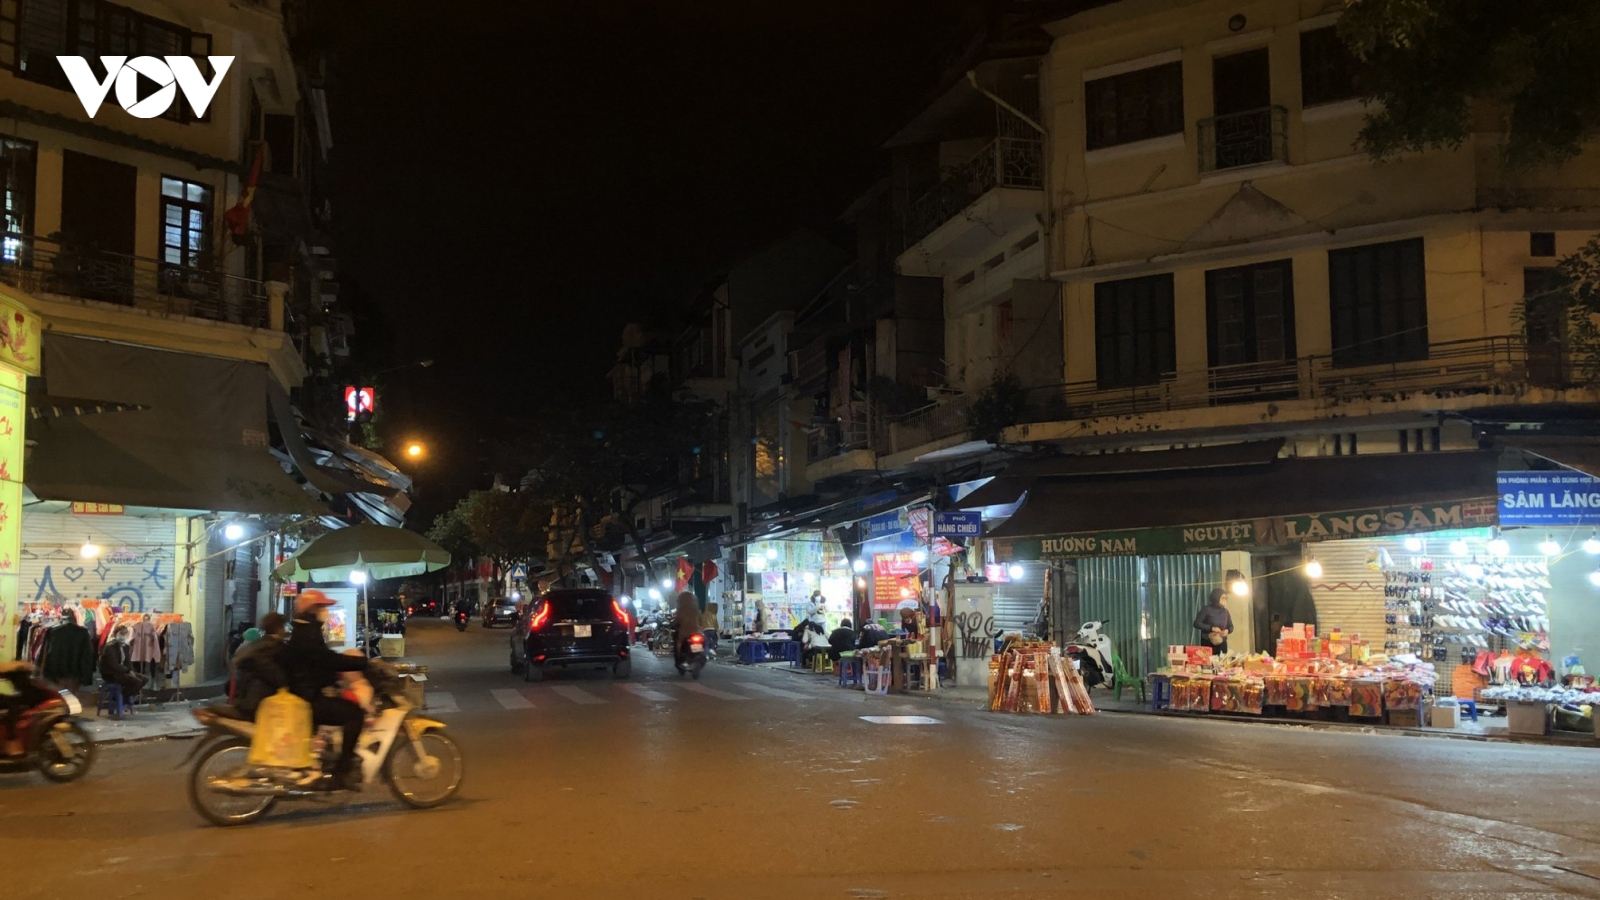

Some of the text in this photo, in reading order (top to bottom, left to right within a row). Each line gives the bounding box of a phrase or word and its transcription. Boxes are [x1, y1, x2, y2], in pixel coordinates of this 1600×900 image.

[1508, 476, 1528, 484] PHÒNG
[1503, 490, 1600, 508] SÂM LĂNG
[937, 521, 977, 533] HÀNG CHIẾU
[1285, 513, 1381, 539] LĂNG
[1384, 505, 1462, 529] SÂM
[1183, 522, 1251, 543] NGUYỆT
[1042, 537, 1137, 553] HƯƠNG NAM
